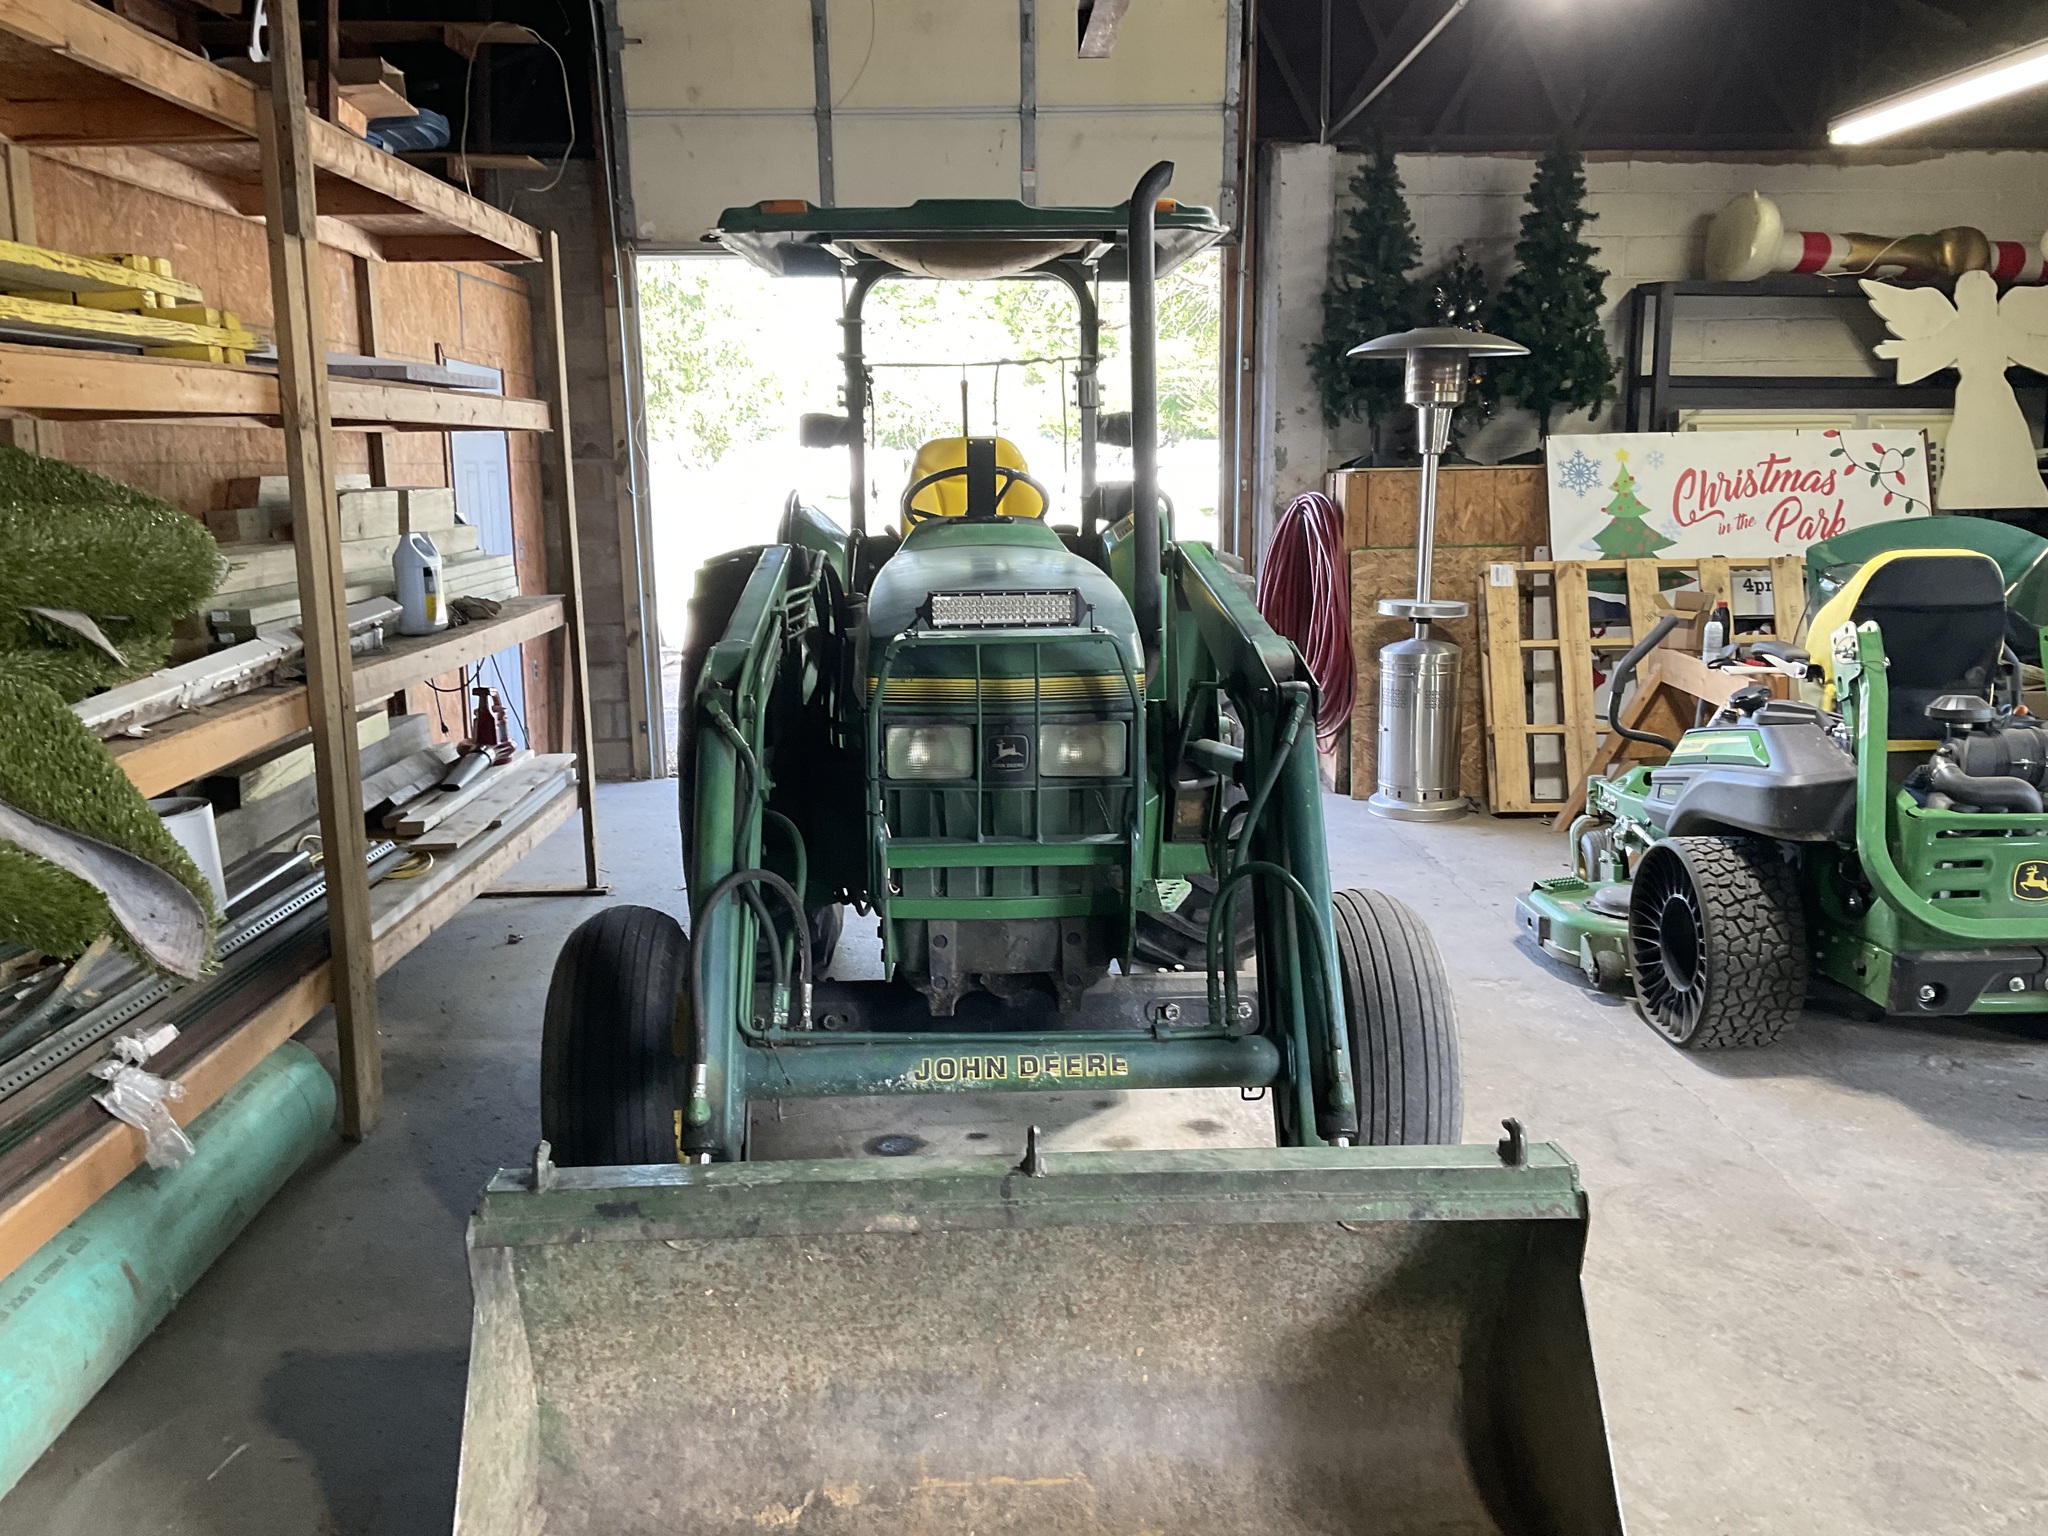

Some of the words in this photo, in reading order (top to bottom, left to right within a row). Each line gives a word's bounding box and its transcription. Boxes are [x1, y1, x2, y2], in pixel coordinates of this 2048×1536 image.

[1673, 453, 1837, 527] Christmas
[1718, 523, 1732, 535] in
[1734, 513, 1755, 530] the
[1766, 496, 1846, 543] Park
[914, 1056, 1008, 1082] JOHN
[1017, 1053, 1129, 1078] DEERE
